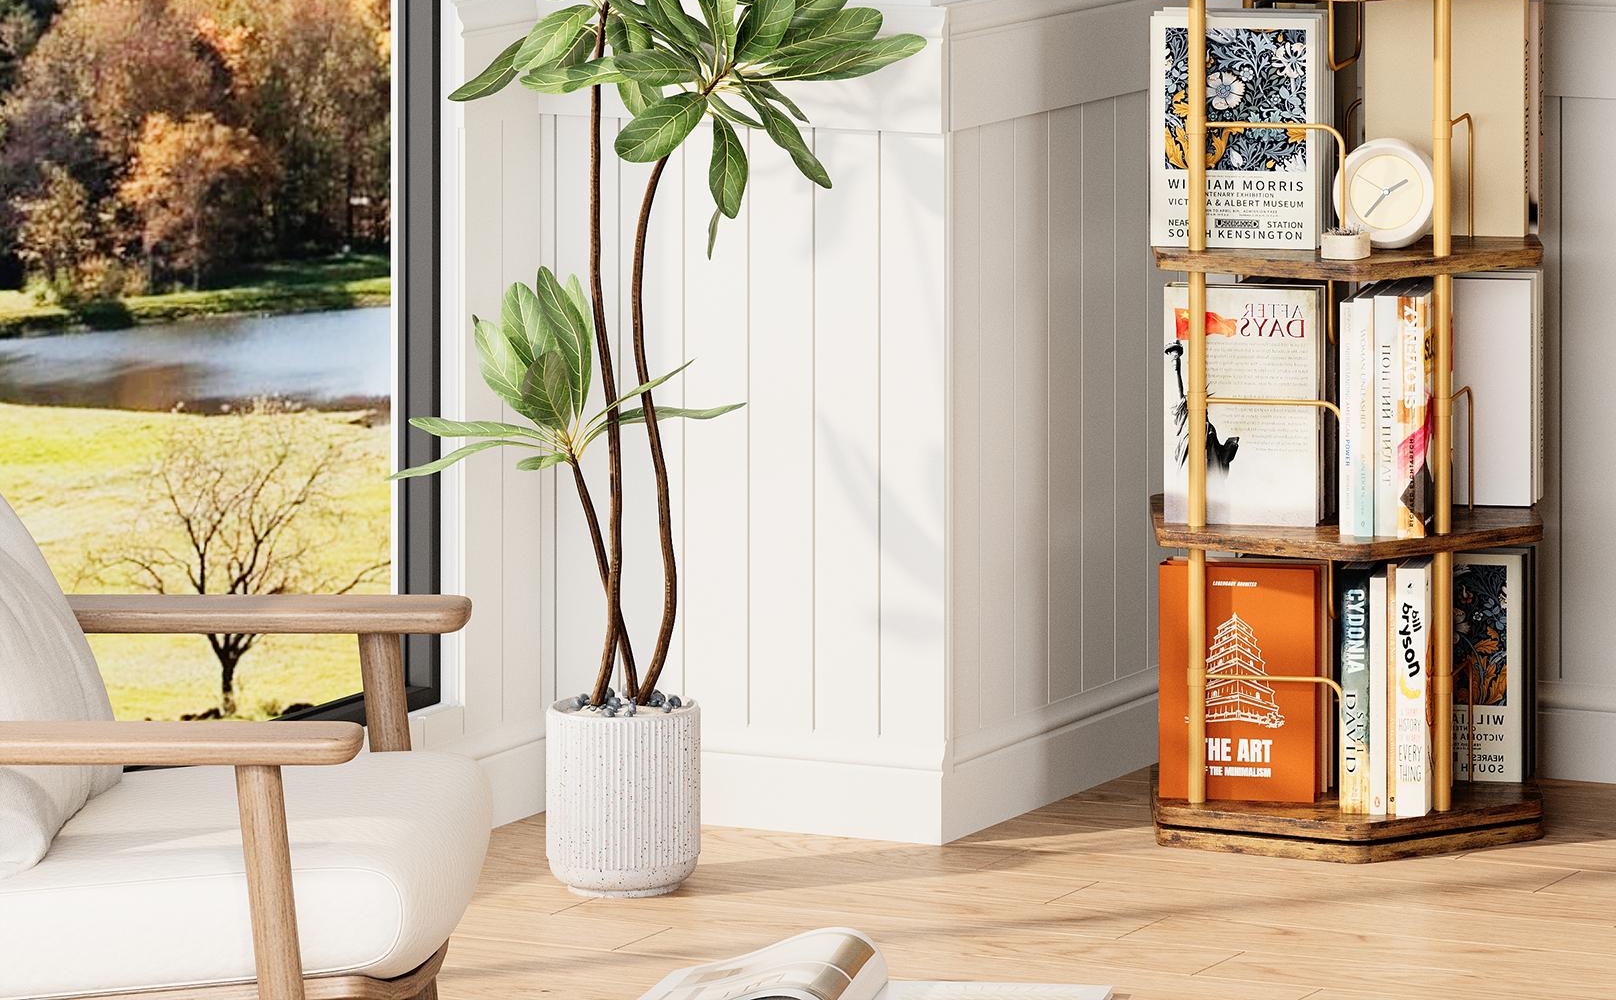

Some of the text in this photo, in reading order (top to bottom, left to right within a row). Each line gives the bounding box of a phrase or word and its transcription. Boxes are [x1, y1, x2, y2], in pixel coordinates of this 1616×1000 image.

[1168, 178, 1304, 192] WIIAM MORRIS
[1168, 198, 1304, 208] VICTA & ALBERT MUSEUM
[1168, 219, 1189, 227] NEAR
[1266, 221, 1303, 229] STATION
[1168, 228, 1303, 240] SOH KENSINGTON
[1382, 345, 1394, 419] ПОНТИЙ
[1411, 610, 1422, 633] bill
[1347, 588, 1365, 674] CYDONIA
[1399, 602, 1421, 678] bryson
[1345, 693, 1357, 773] DAVID
[1205, 738, 1273, 763] HE ART
[1399, 744, 1422, 762] EVERY
[1209, 766, 1224, 776] THE
[1399, 765, 1422, 783] THING
